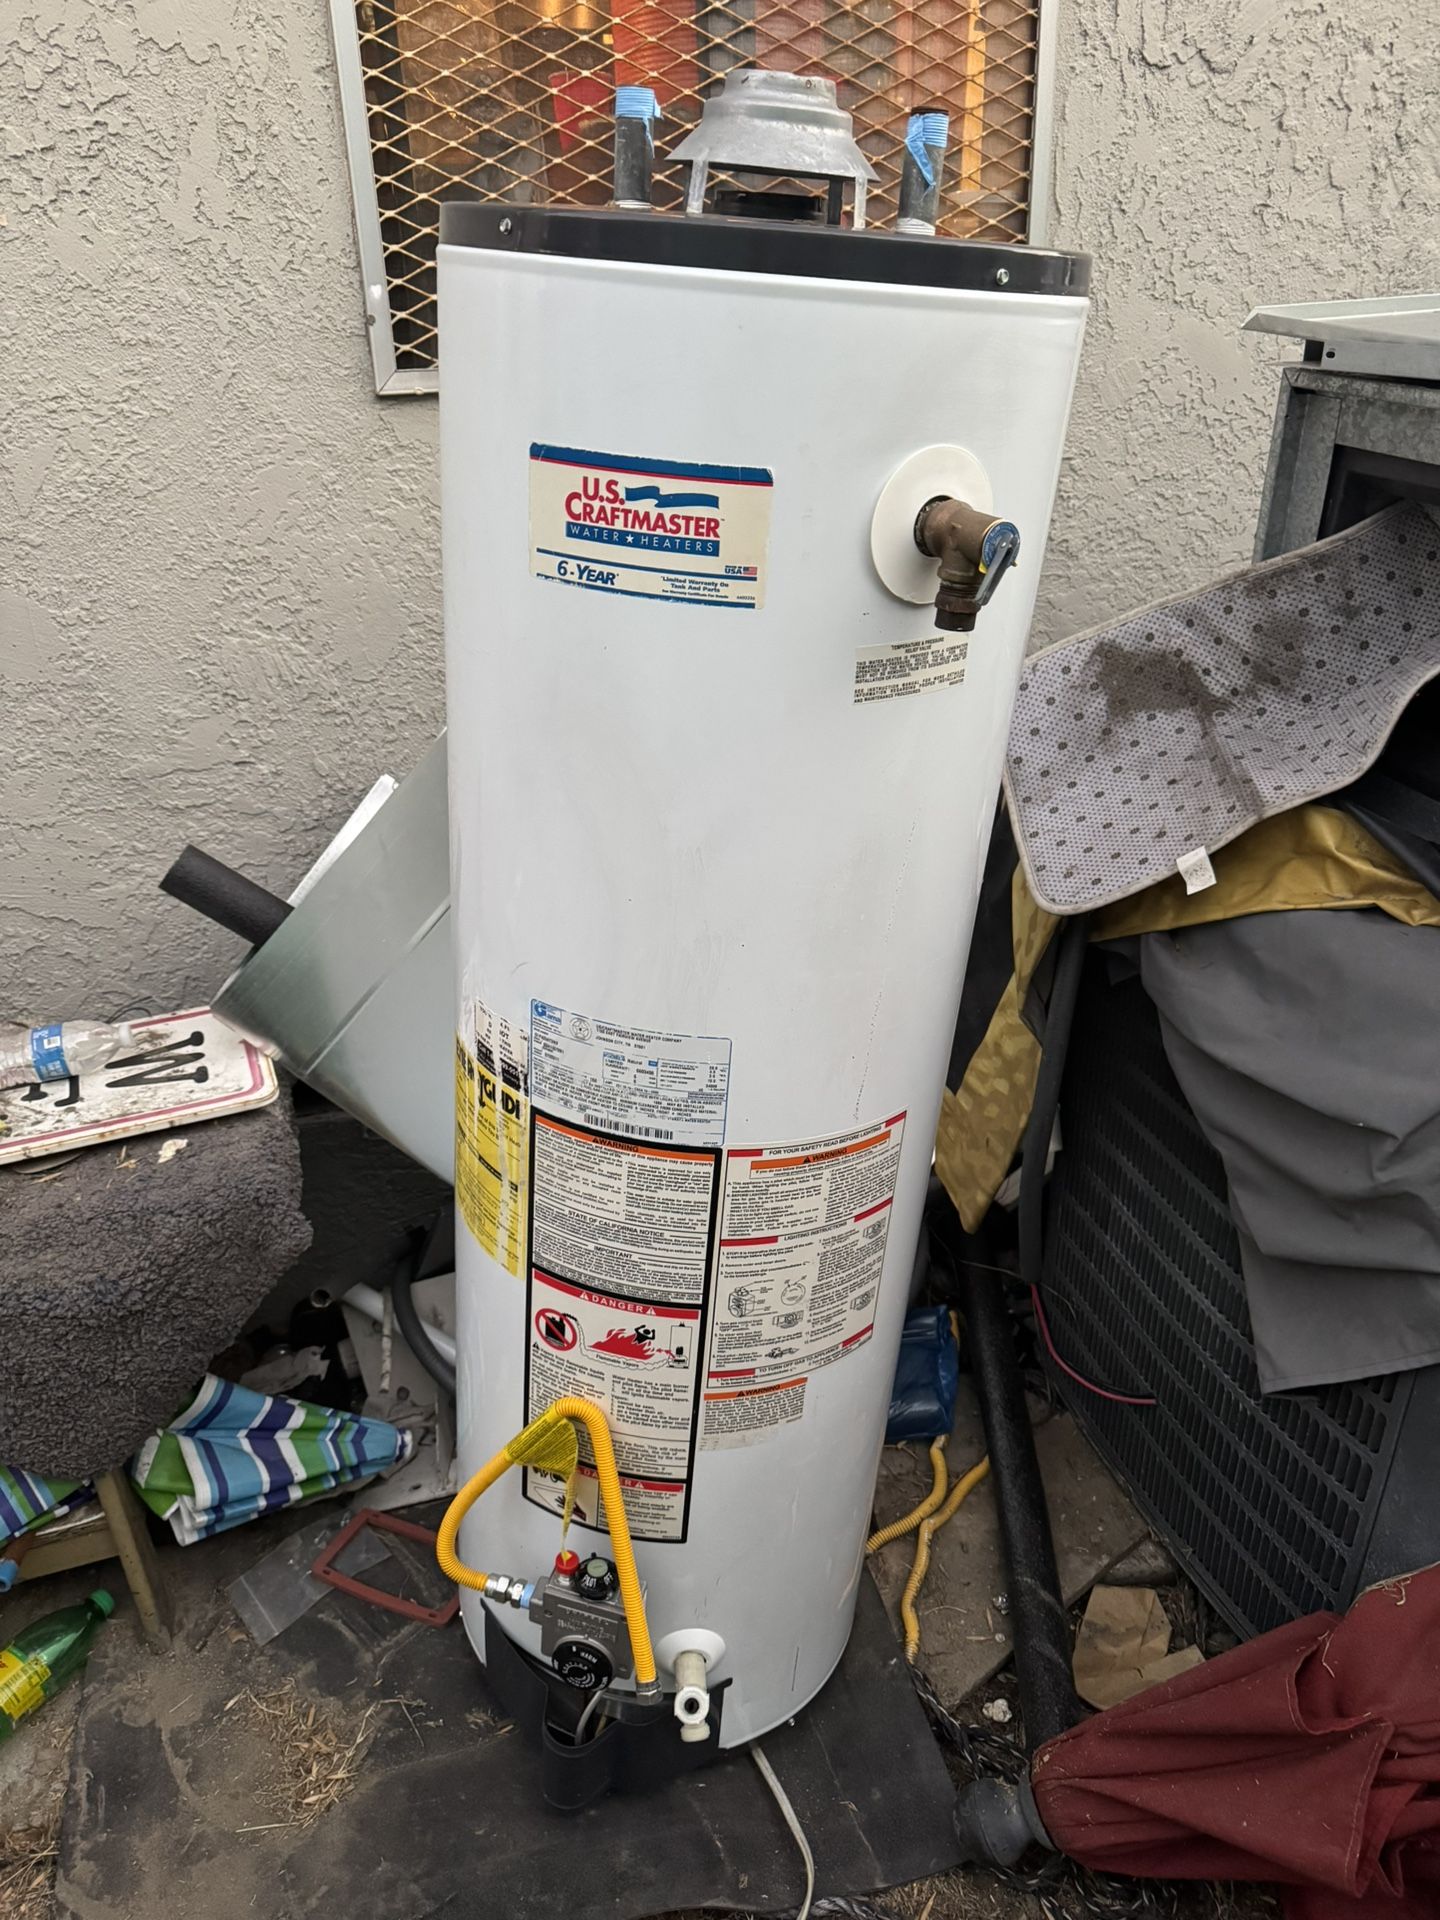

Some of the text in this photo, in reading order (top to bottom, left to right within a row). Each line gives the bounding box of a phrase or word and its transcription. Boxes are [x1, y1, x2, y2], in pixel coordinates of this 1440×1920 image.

[582, 476, 625, 505] U.S.
[565, 492, 720, 538] CRAFTMASTER
[570, 525, 713, 553] WATER HEATERS
[840, 1134, 860, 1144] BEFORE
[860, 1126, 882, 1137] LIGHTING
[600, 1138, 639, 1152] WARNING
[812, 1148, 848, 1161] WARNING
[568, 1210, 588, 1221] STATE
[598, 1219, 638, 1234] CALIFORNIA
[639, 1228, 665, 1238] NOTICE
[810, 1222, 848, 1237] INSTRUCTIONS
[594, 1245, 633, 1260] IMPORTANT
[592, 1295, 644, 1313] DANGER
[814, 1346, 839, 1358] APPLIANCE
[746, 1384, 780, 1395] WARNING
